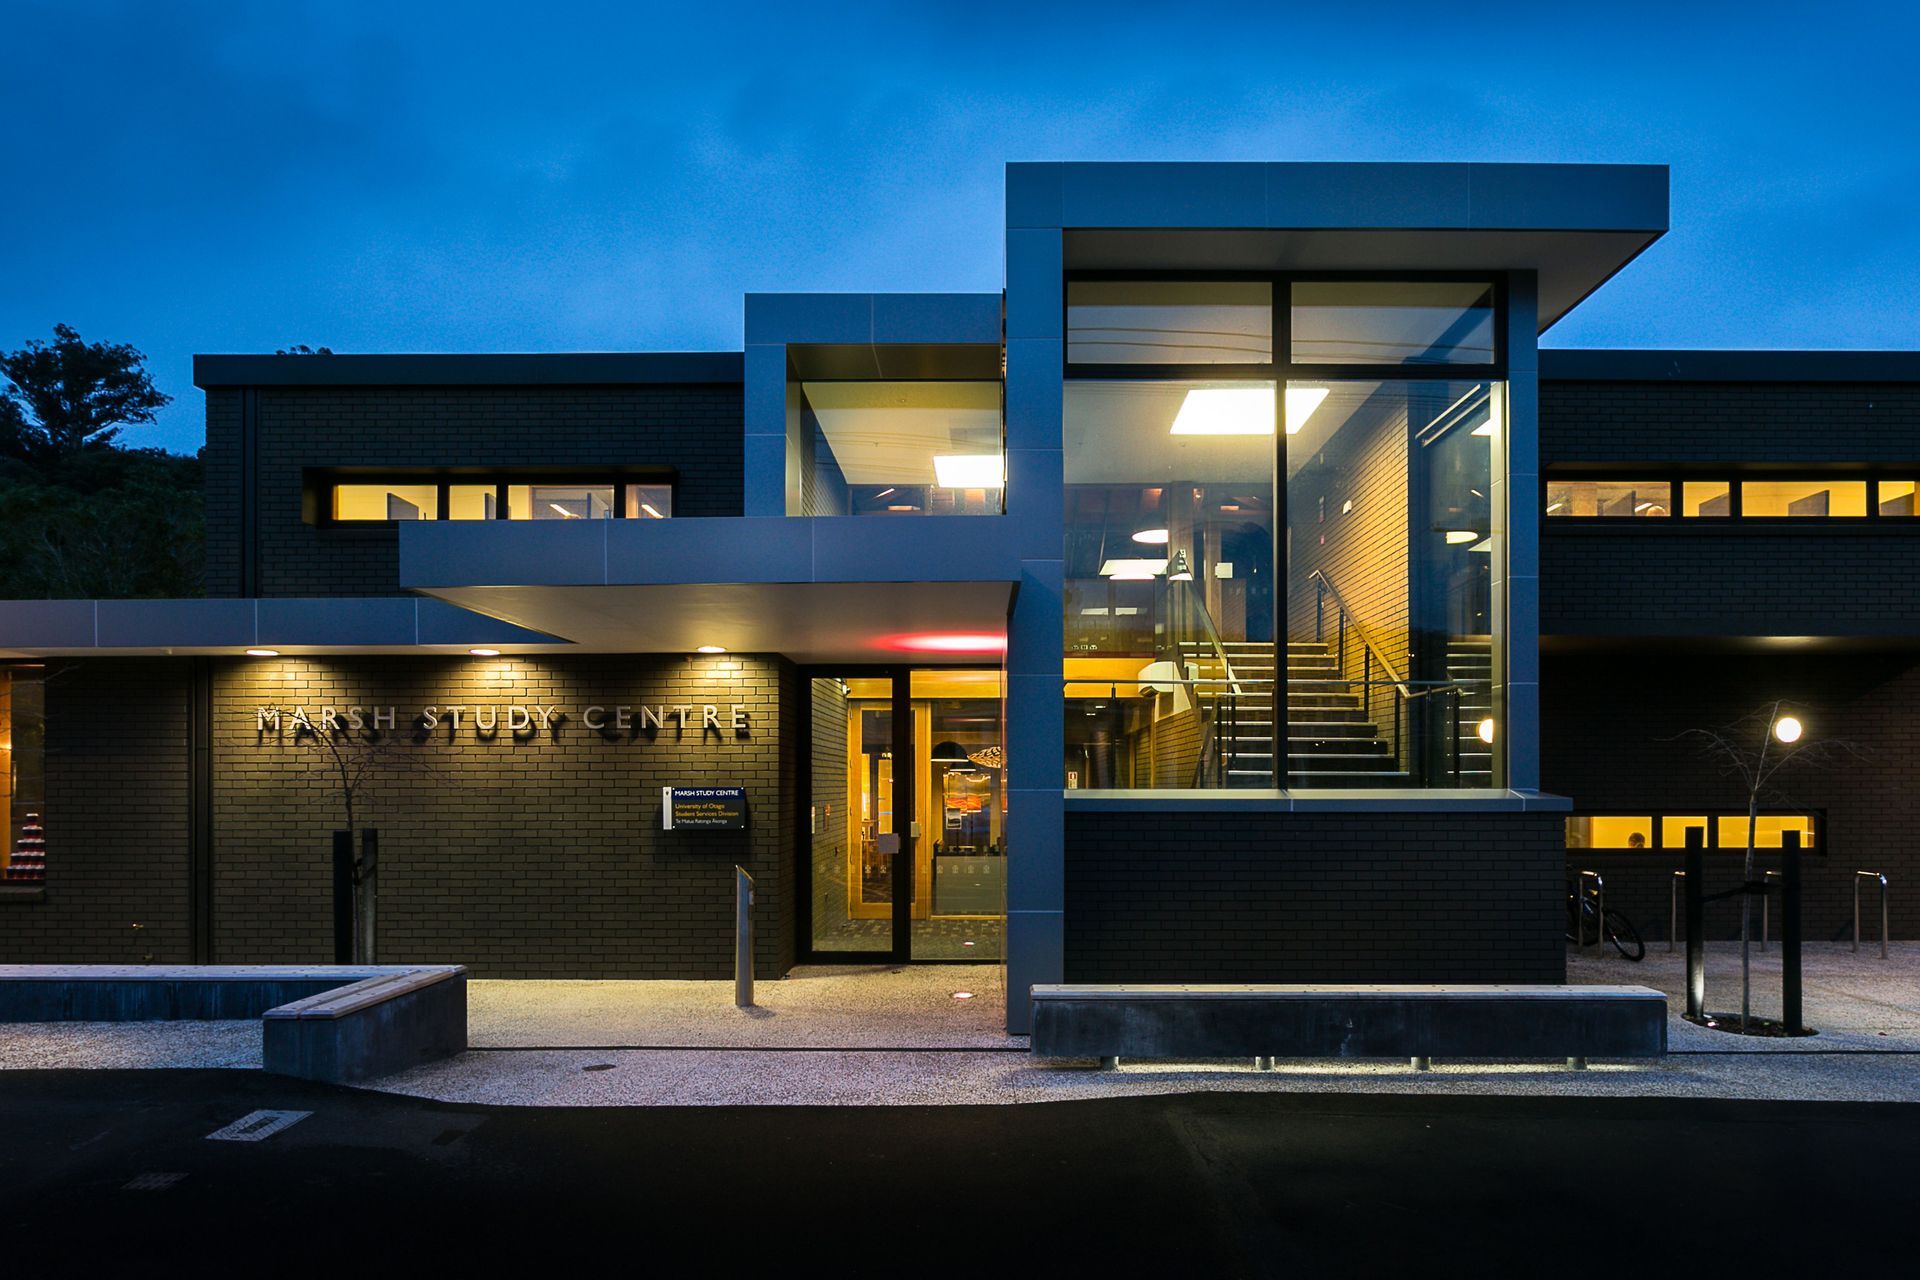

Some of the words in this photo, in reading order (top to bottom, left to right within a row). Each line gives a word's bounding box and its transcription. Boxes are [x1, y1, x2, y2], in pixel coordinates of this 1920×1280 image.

[257, 705, 396, 731] MARSH
[423, 705, 556, 730] STUDY
[583, 704, 748, 729] CENTRE
